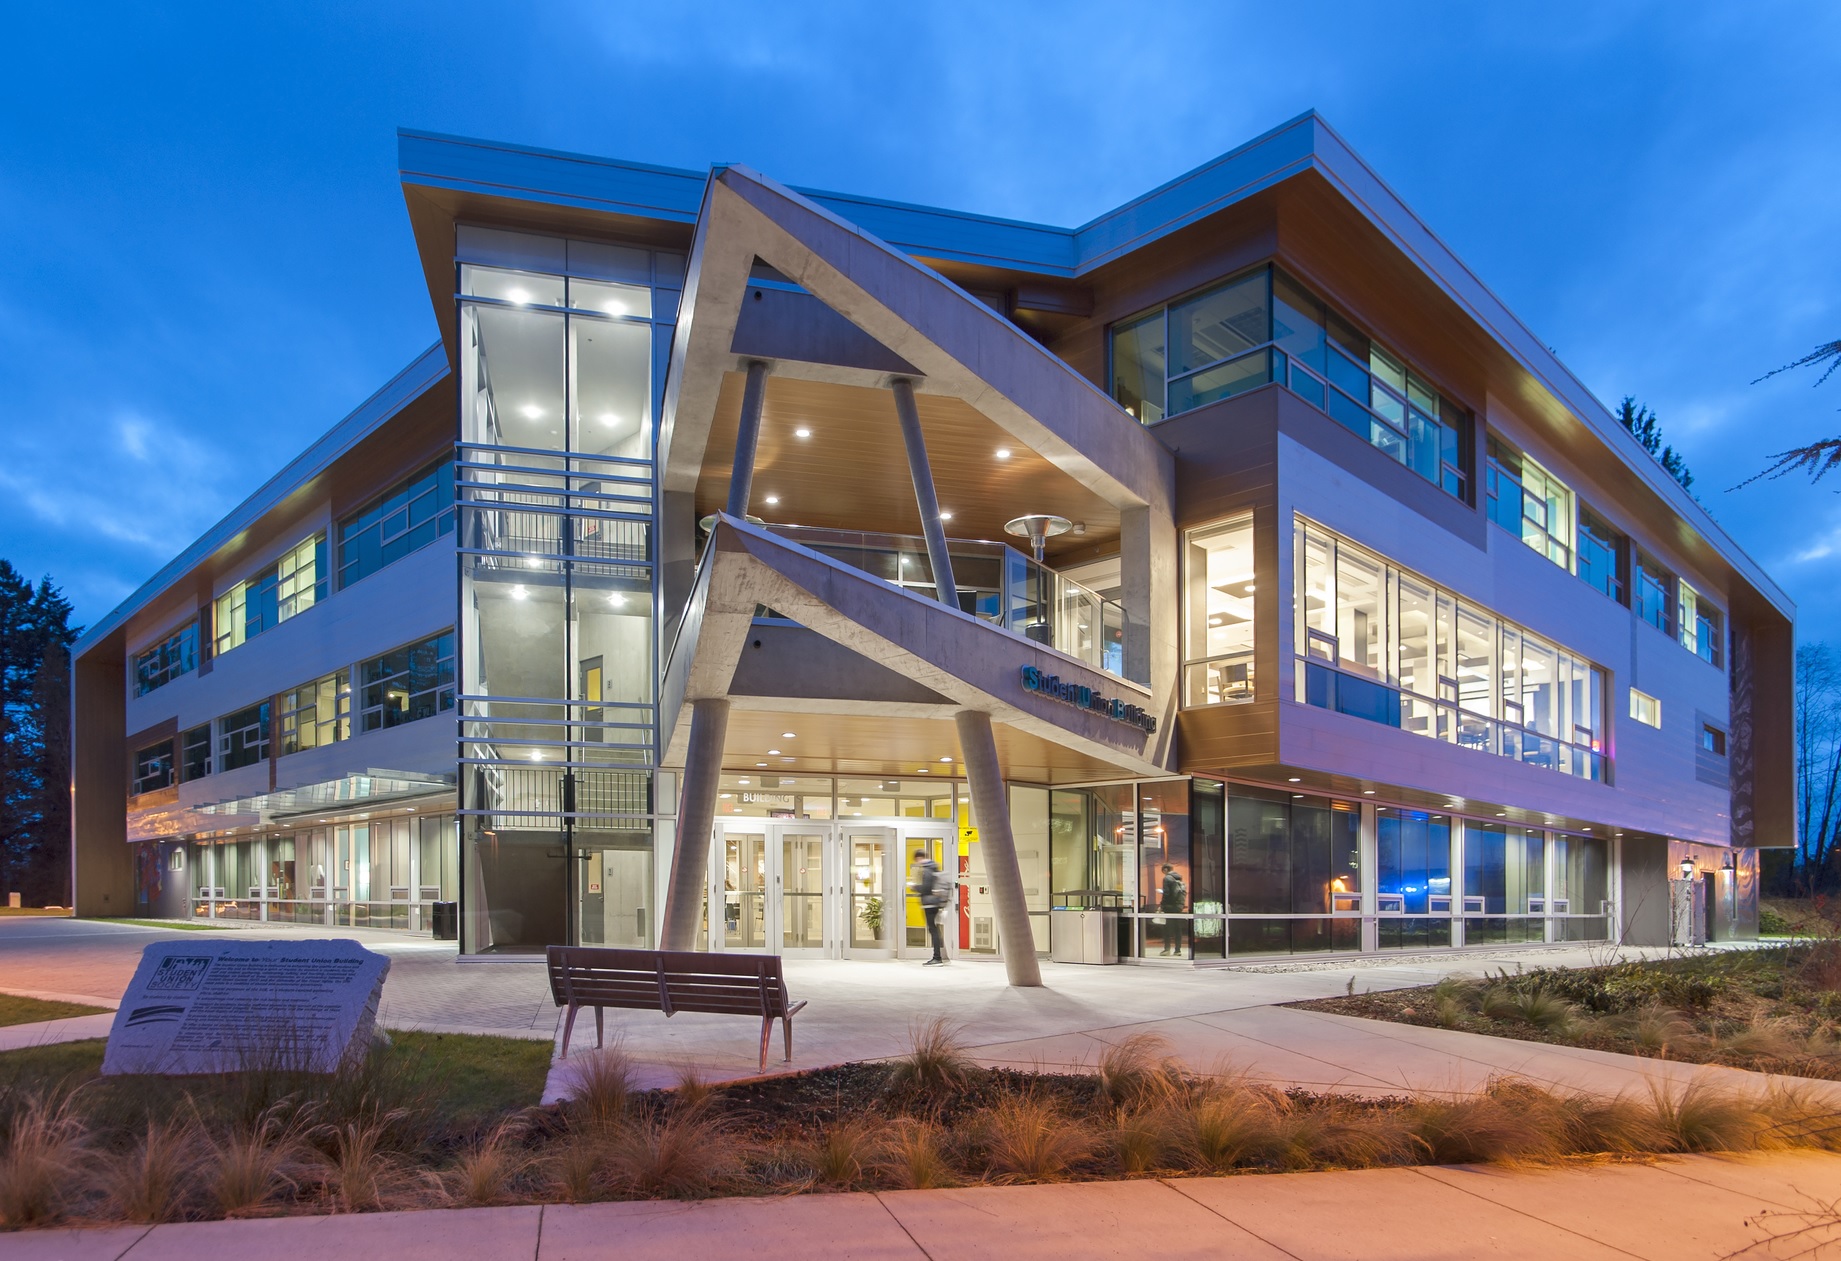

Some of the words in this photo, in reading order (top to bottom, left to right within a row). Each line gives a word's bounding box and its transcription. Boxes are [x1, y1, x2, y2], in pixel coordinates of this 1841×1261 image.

[743, 793, 790, 803] BUILDING
[157, 969, 205, 977] STUDENT
[150, 981, 198, 989] SOCIETY
